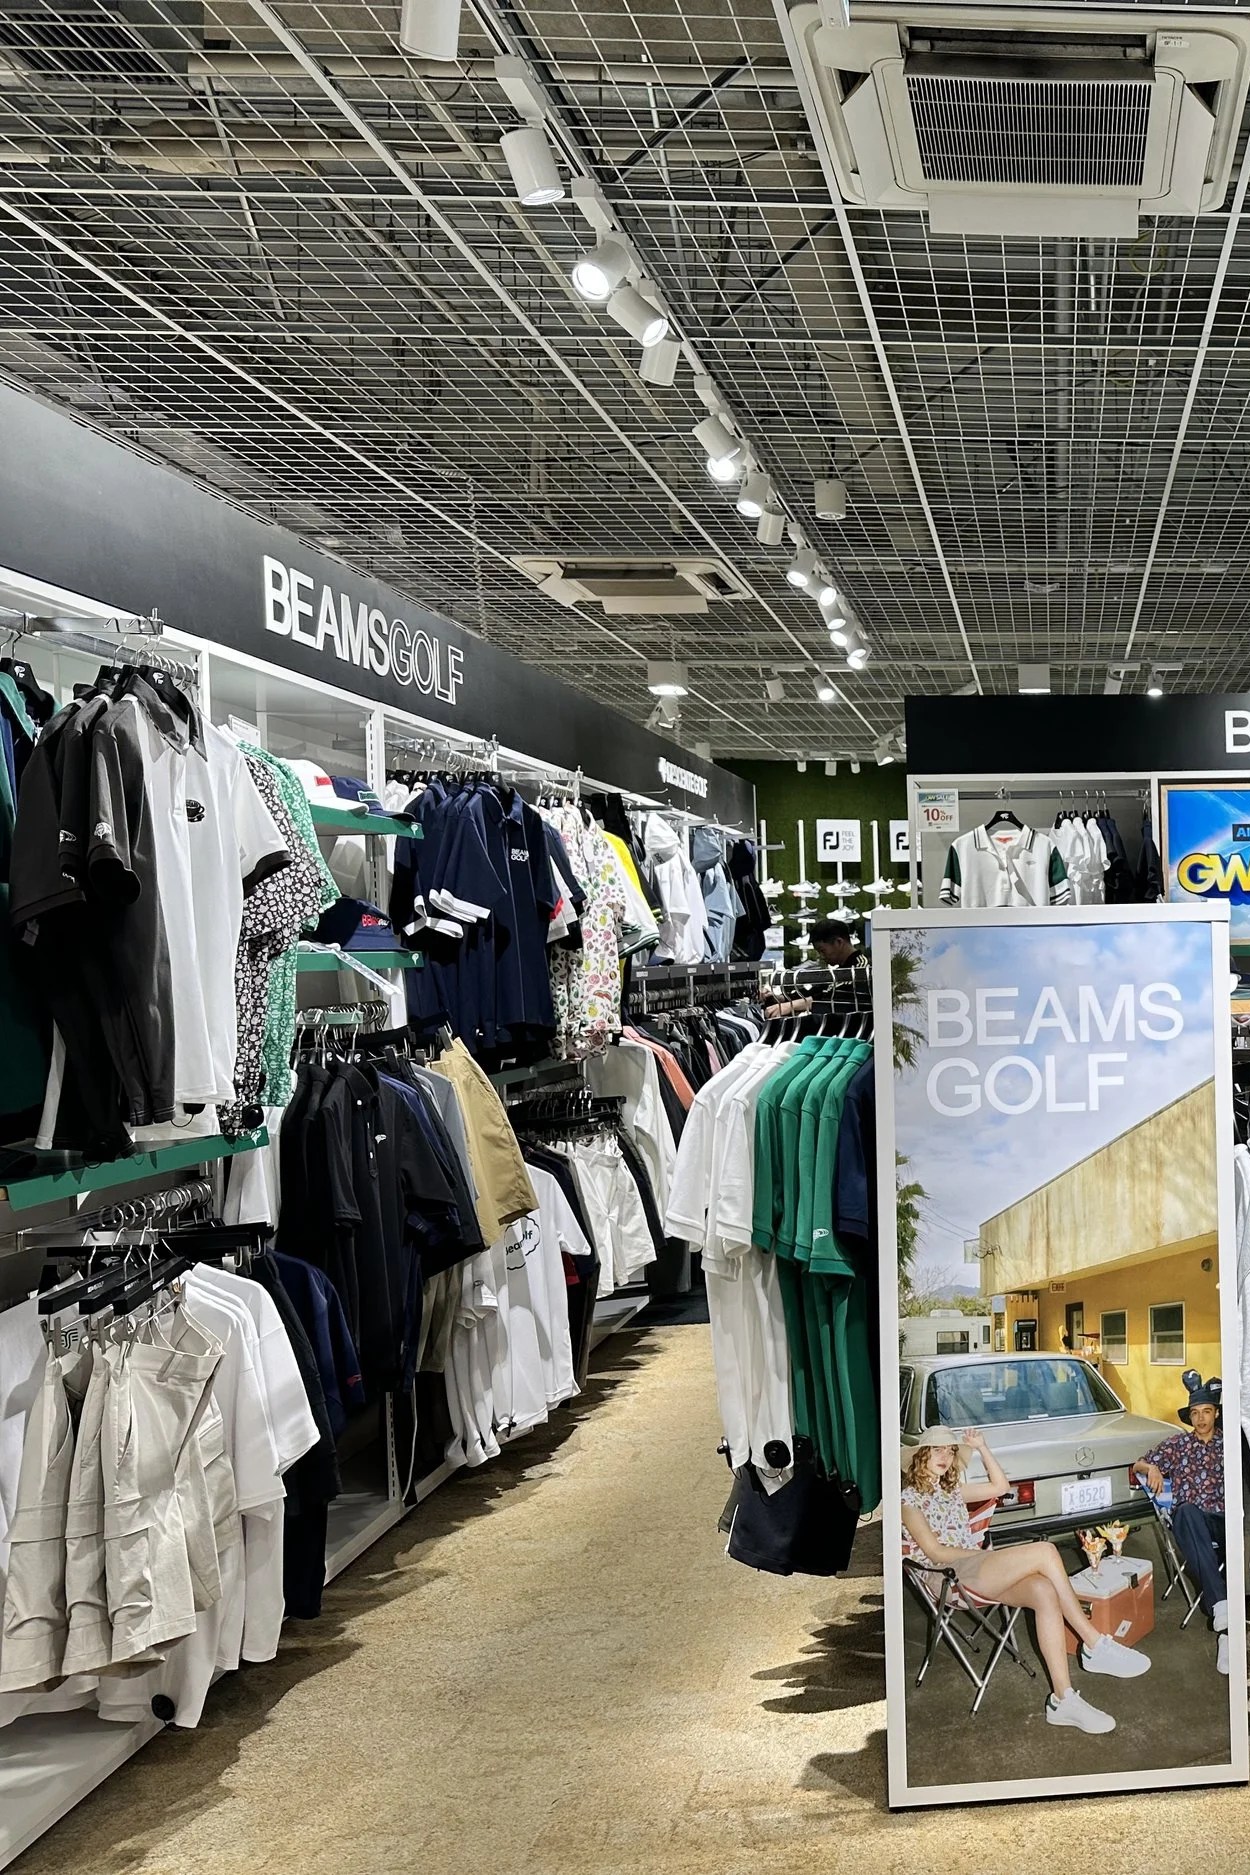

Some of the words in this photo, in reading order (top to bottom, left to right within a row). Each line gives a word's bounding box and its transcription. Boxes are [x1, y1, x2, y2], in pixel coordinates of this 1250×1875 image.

[823, 831, 840, 850] FJ
[927, 982, 1184, 1048] BEAMS
[926, 1052, 1128, 1117] GOLF
